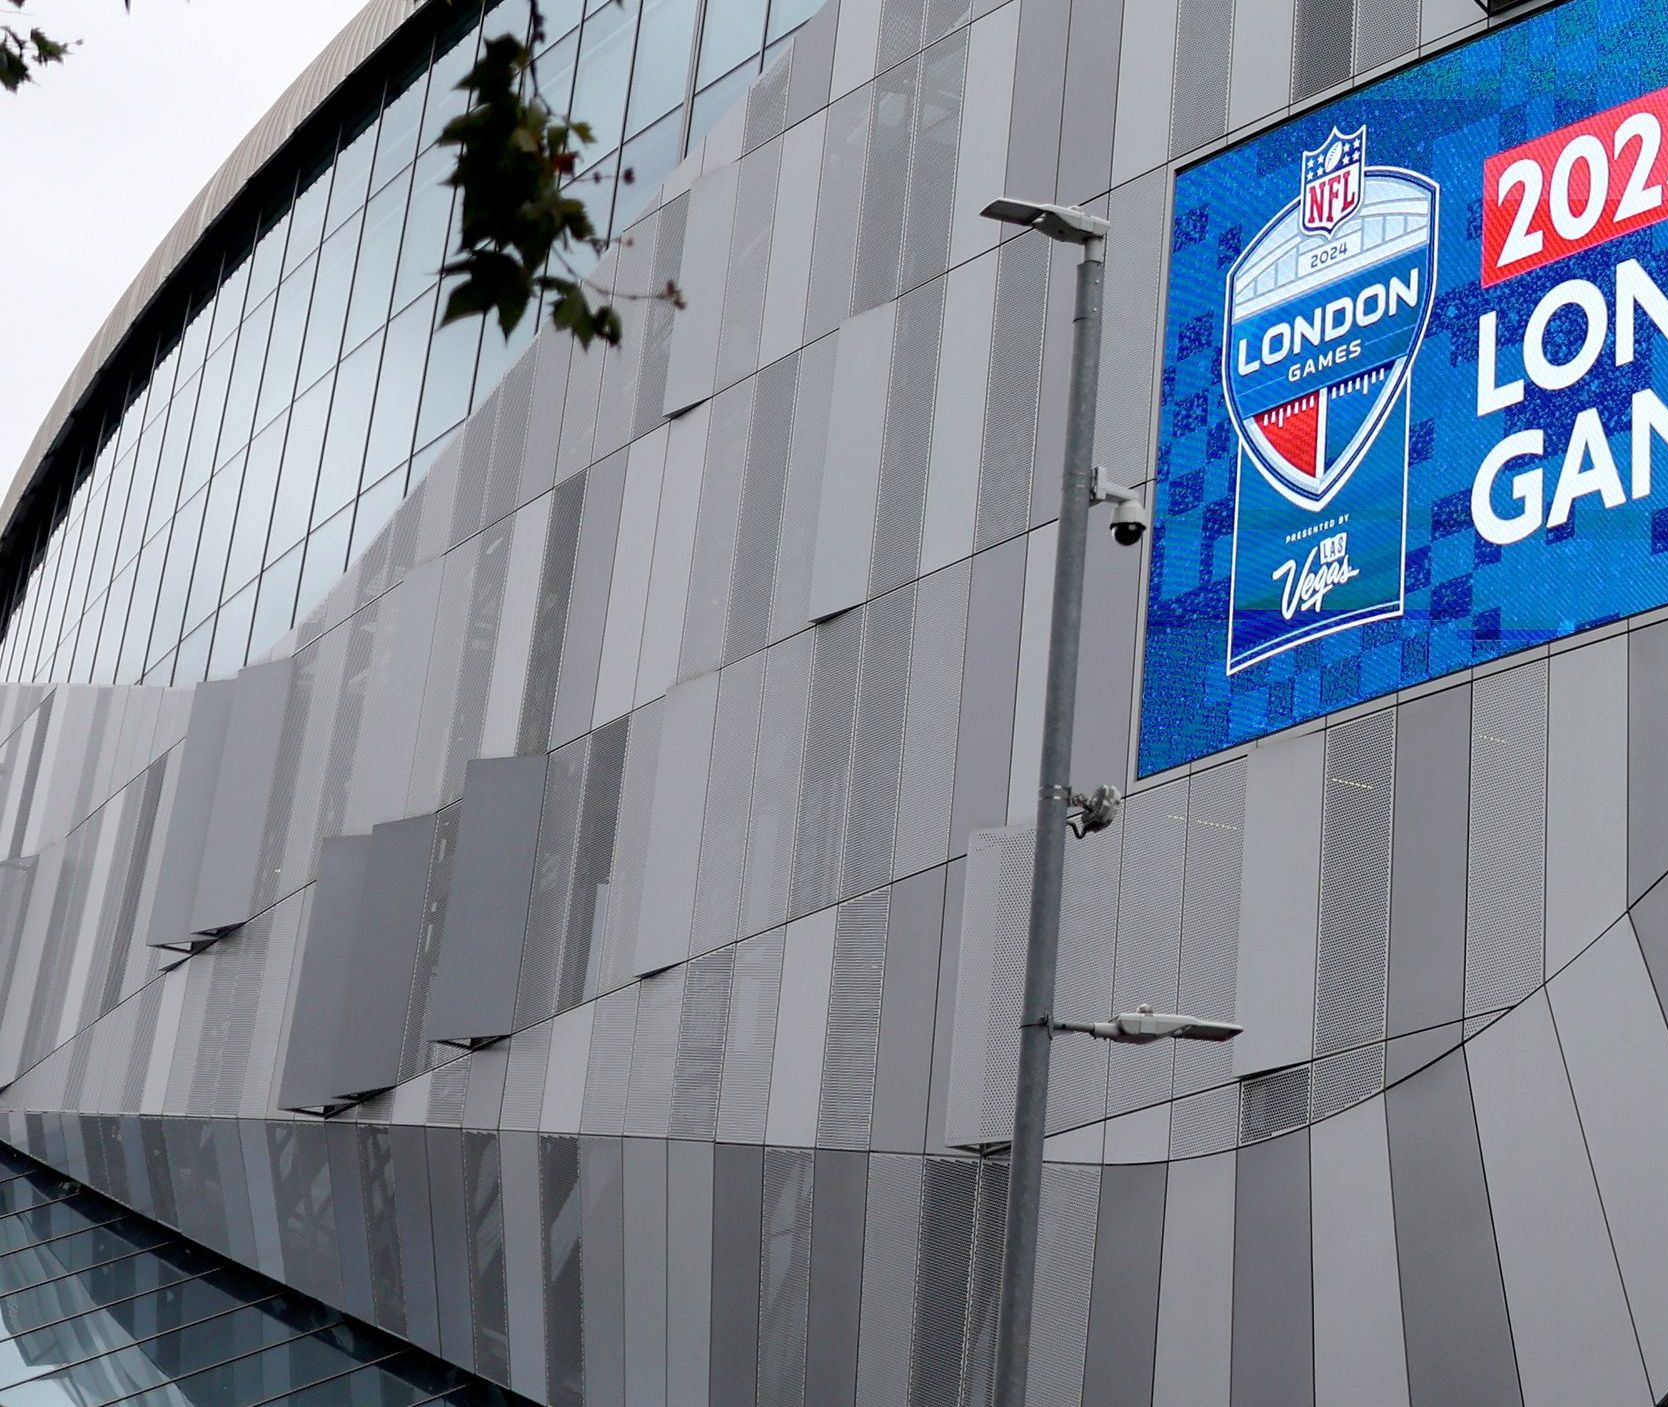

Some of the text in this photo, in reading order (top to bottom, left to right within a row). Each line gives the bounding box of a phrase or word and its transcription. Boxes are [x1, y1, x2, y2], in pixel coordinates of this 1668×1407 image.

[1307, 170, 1356, 225] NFL
[1310, 242, 1348, 269] 2024
[1237, 268, 1419, 376] LONDON
[1288, 339, 1362, 382] GAMES
[1285, 513, 1350, 544] PRESENTED BY
[1322, 535, 1345, 560] LAS
[1272, 546, 1360, 620] Vegas
